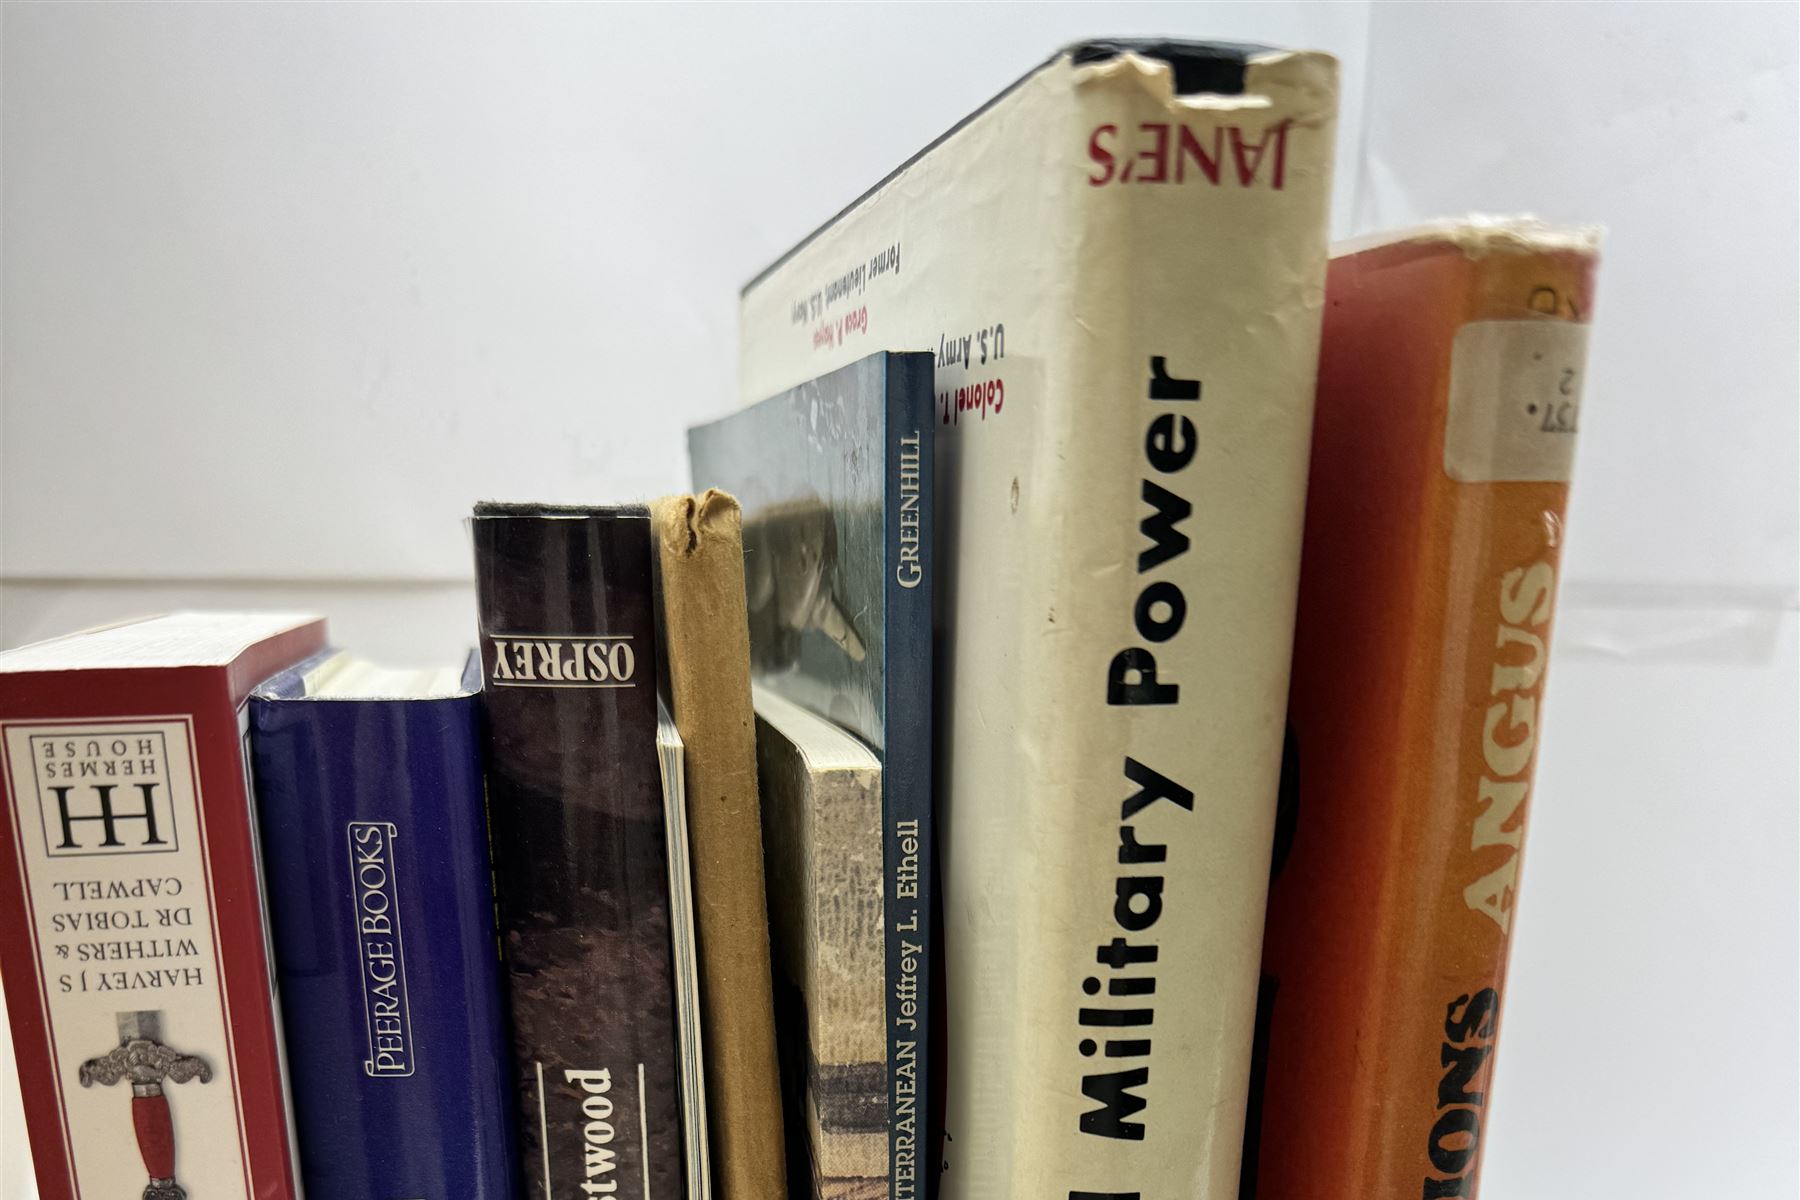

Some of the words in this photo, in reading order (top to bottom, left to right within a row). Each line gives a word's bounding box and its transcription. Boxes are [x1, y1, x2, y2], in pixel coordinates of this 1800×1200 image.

[1088, 119, 1293, 190] JANE'S
[868, 242, 900, 280] Former
[977, 323, 1004, 365] U.S.
[939, 391, 951, 425] T.
[953, 378, 1004, 426] Colonel
[1107, 356, 1202, 706] Power
[492, 640, 635, 681] OSPREY
[43, 740, 153, 758] HOUSE
[1463, 561, 1554, 936] ANGUS
[45, 759, 156, 778] HERMES
[896, 819, 919, 899] Ethell
[53, 877, 182, 901] CAPWELL
[357, 825, 392, 935] BOOKS
[52, 910, 150, 932] TOBIAS
[156, 907, 192, 926] DR
[896, 909, 919, 932] L.
[55, 944, 70, 958] &
[77, 939, 200, 962] WITHERS
[1079, 755, 1195, 1141] Military
[59, 975, 73, 992] S
[80, 970, 87, 992] J
[97, 967, 202, 991] HARVEY
[895, 940, 922, 1031] Jeffrey
[368, 942, 406, 1073] PEERAGE
